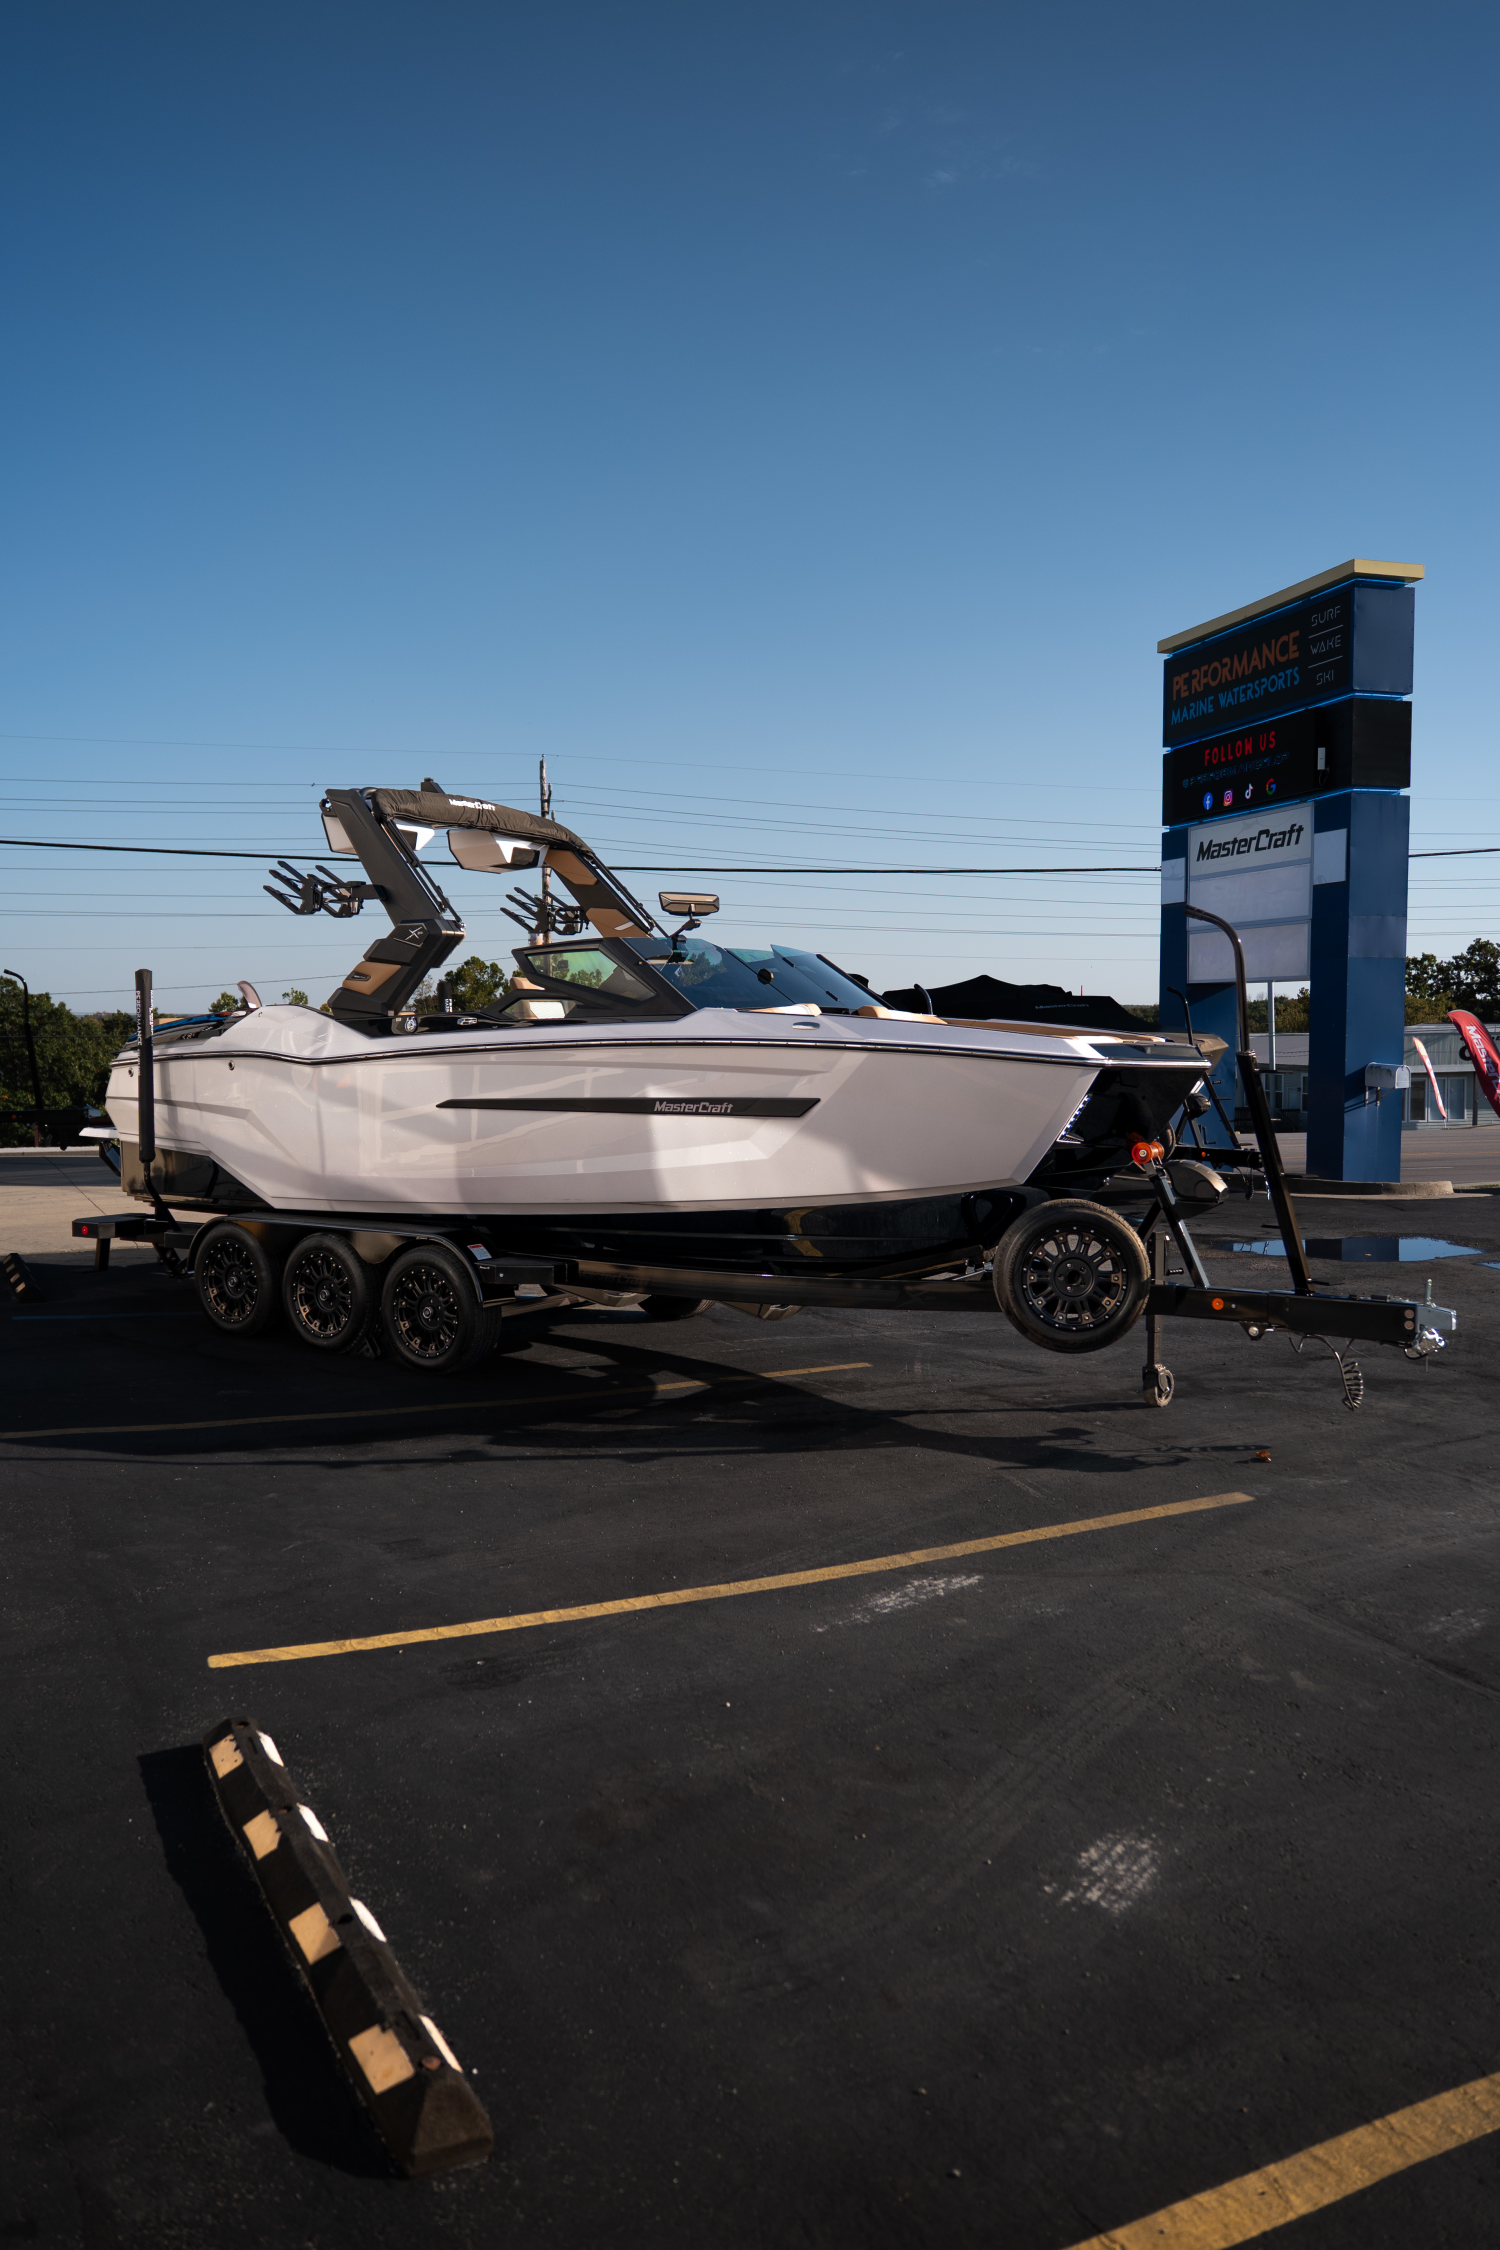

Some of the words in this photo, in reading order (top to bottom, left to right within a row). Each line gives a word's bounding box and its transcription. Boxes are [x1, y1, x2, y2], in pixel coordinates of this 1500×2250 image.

[1311, 605, 1341, 627] SURF
[1310, 634, 1342, 655] WAKE
[1173, 630, 1300, 701] PERFORMANCE
[1316, 669, 1334, 686] SKI
[1171, 695, 1214, 726] MARINE
[1218, 666, 1300, 709] WATERSPORTS
[1204, 736, 1253, 767] FOLLOW
[1259, 731, 1276, 750] US
[1196, 823, 1305, 862] MasterCraft
[653, 1101, 734, 1113] MasterCraft
